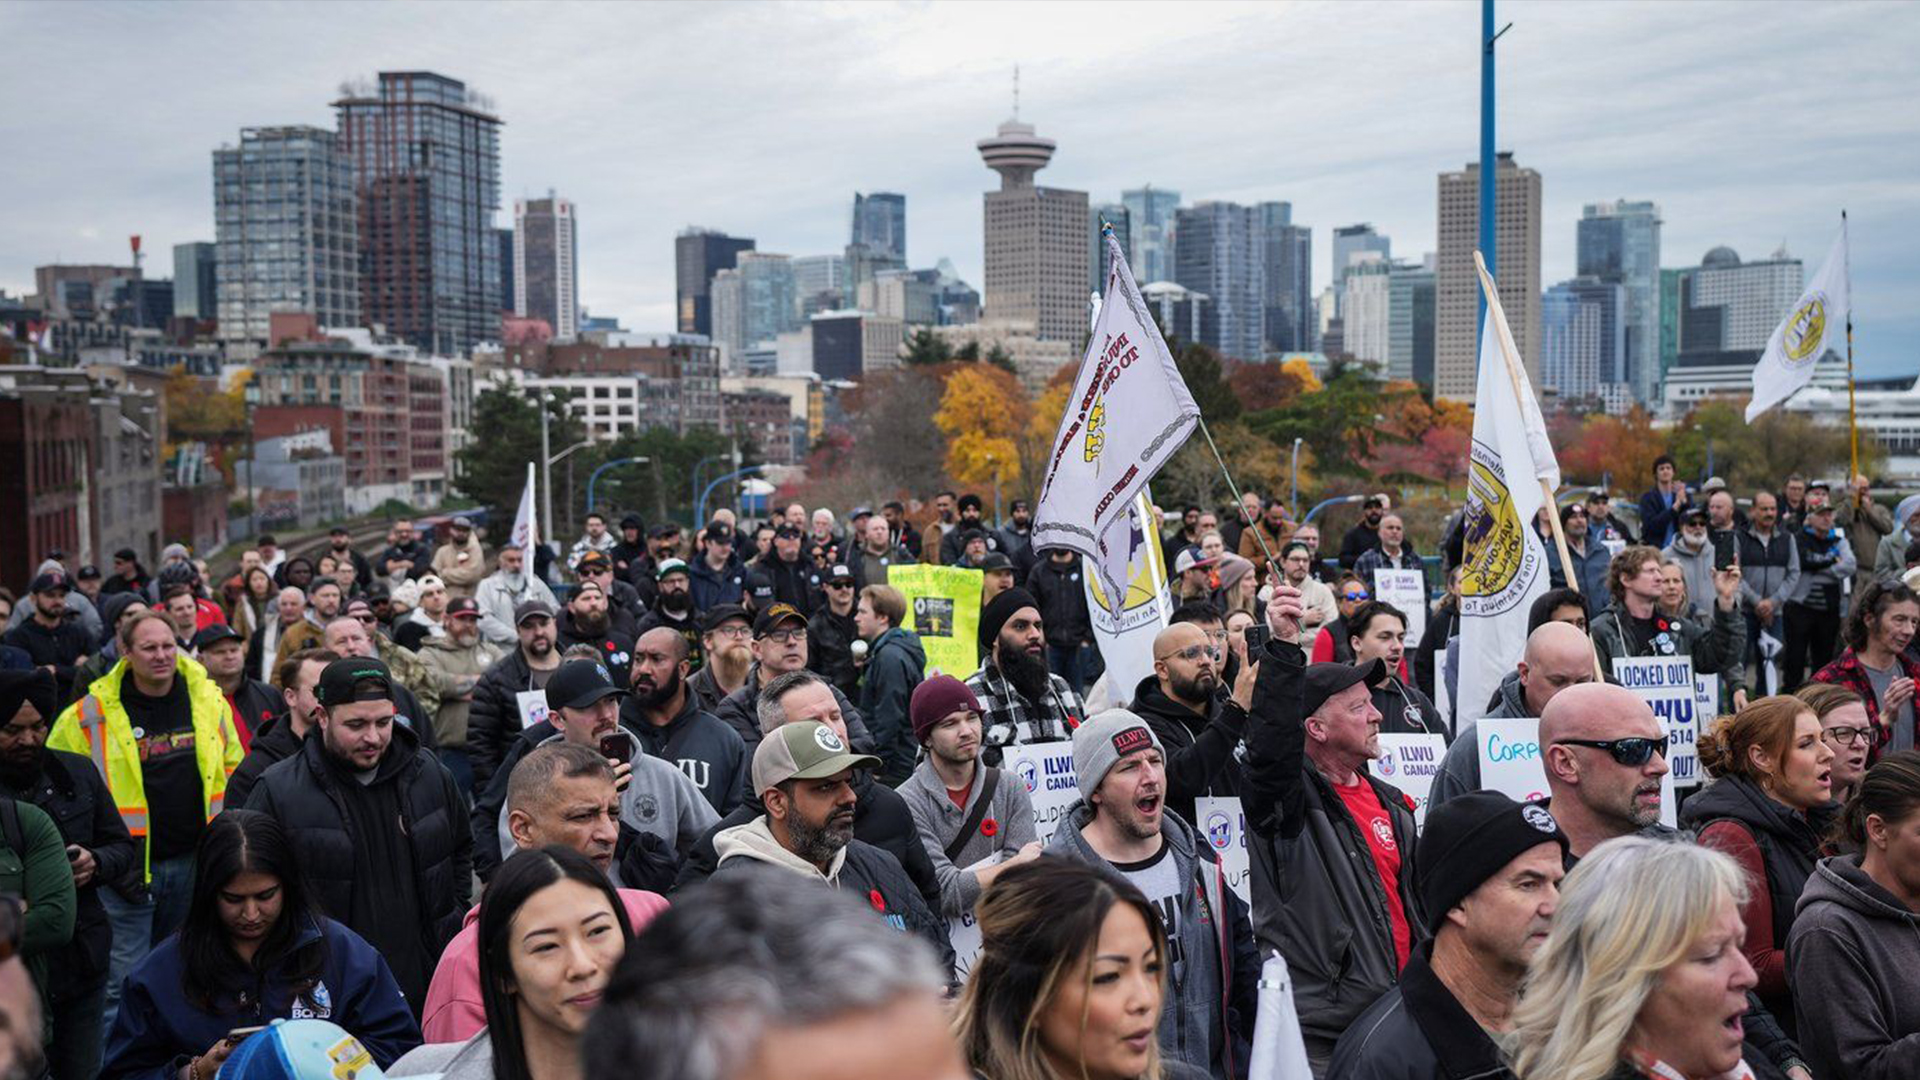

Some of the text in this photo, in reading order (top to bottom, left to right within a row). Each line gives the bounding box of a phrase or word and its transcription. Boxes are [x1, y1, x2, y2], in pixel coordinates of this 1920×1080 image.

[1617, 663, 1689, 687] LOCKED OUT
[1115, 728, 1147, 747] ILWU
[1671, 729, 1693, 745] 514
[1399, 746, 1434, 762] ILWU
[1673, 756, 1694, 777] OUT
[1046, 777, 1078, 791] CANA
